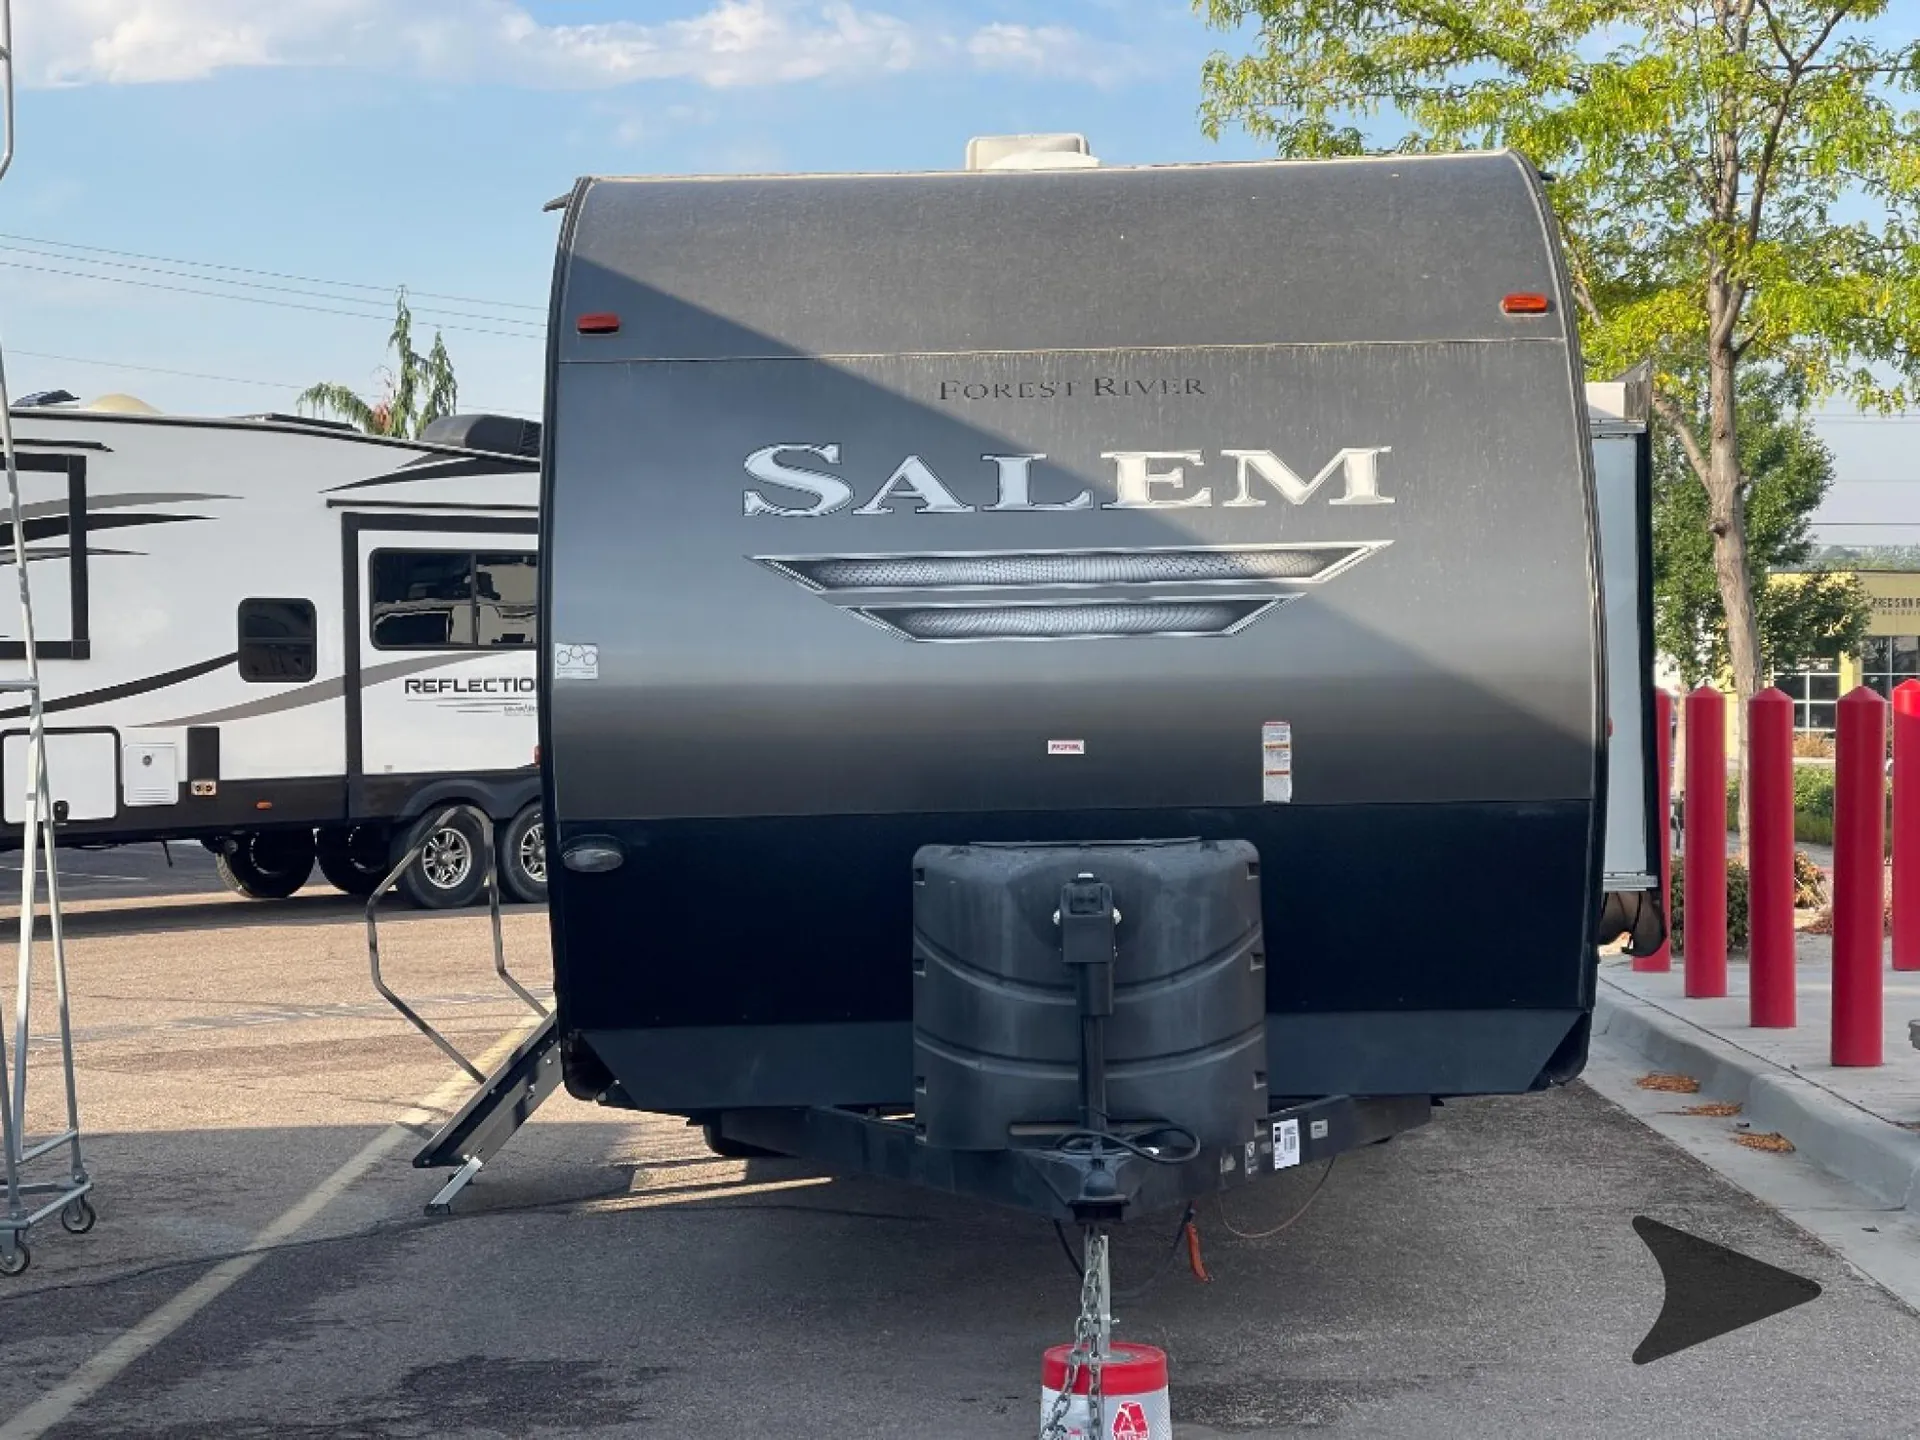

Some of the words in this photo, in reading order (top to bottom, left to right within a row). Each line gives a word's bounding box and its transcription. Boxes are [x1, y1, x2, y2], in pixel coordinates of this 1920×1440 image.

[939, 380, 1081, 400] FOREST
[1093, 377, 1206, 397] RIVER
[742, 441, 1396, 518] SALEM
[404, 678, 536, 694] REFLECTIO
